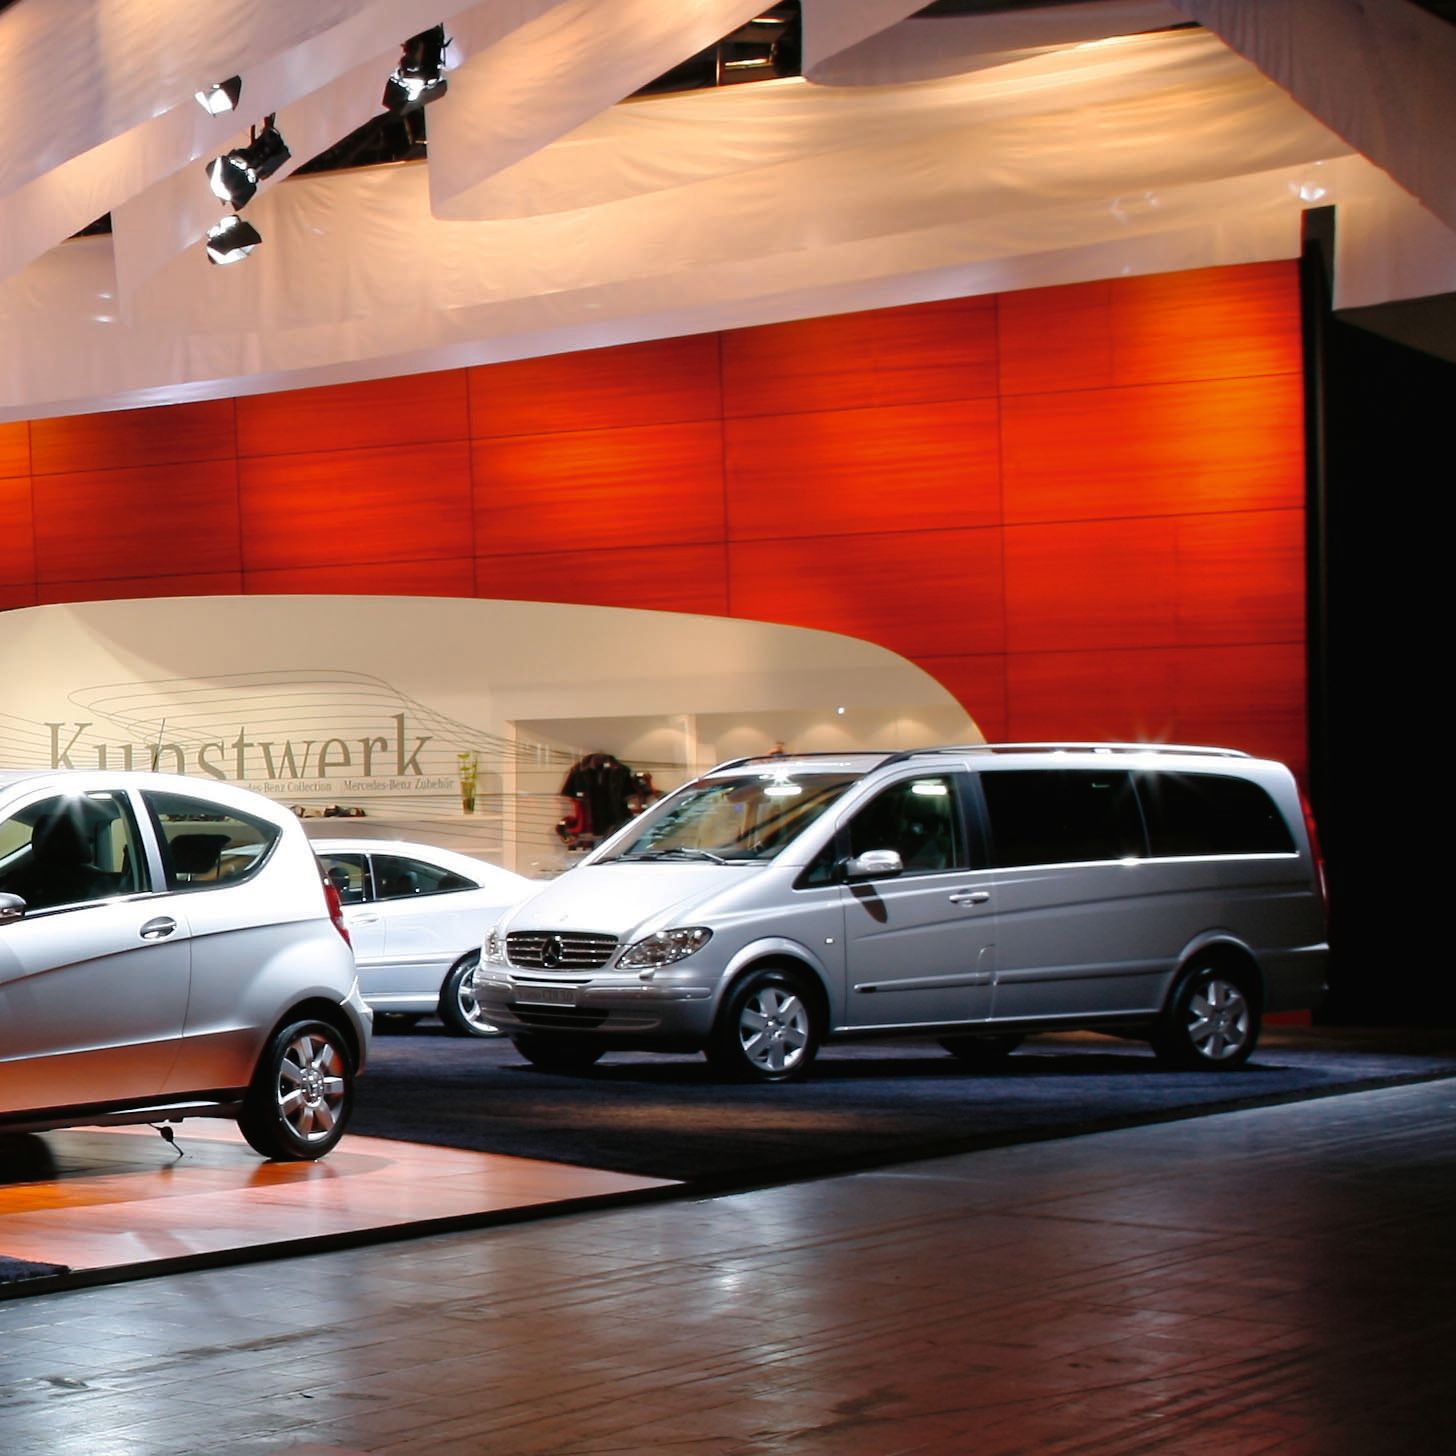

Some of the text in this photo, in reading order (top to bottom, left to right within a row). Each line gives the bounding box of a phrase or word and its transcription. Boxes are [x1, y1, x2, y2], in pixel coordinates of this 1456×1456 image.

[46, 713, 433, 779] Kunstwerk
[288, 781, 332, 793] Collection
[344, 779, 411, 791] Mercedes-Benz
